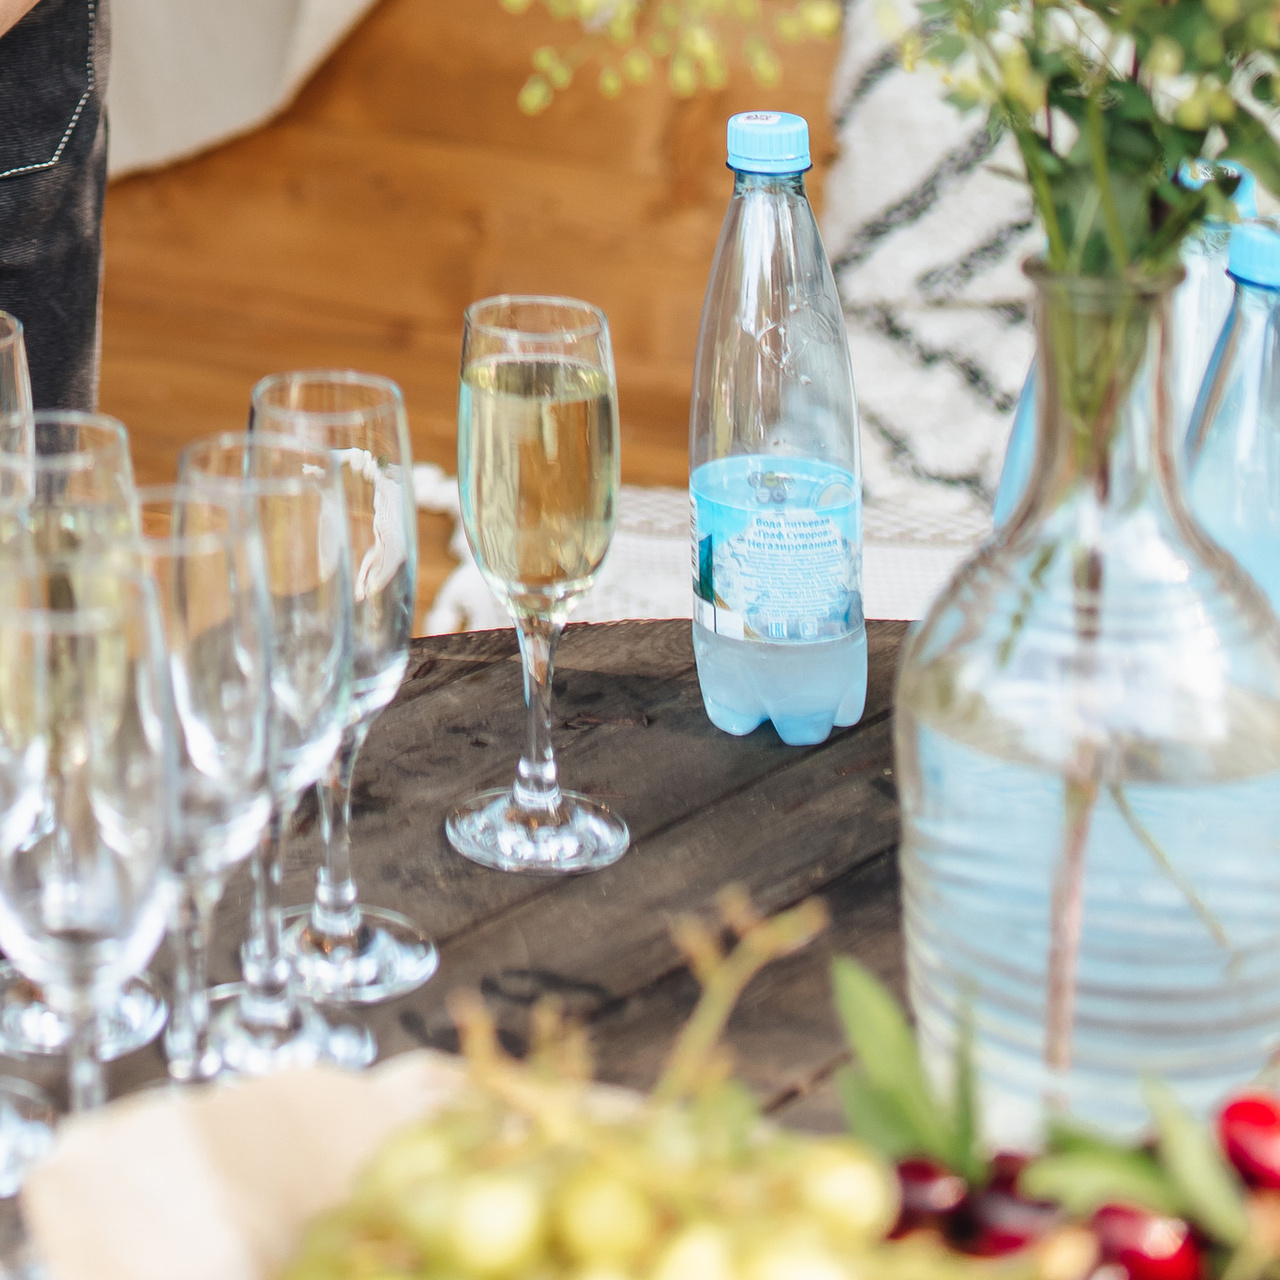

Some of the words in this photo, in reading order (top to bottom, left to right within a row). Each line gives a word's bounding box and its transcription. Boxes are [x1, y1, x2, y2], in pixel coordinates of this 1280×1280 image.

[755, 517, 782, 529] Вода
[784, 518, 830, 528] питьевая
[747, 538, 838, 553] Негазированная
